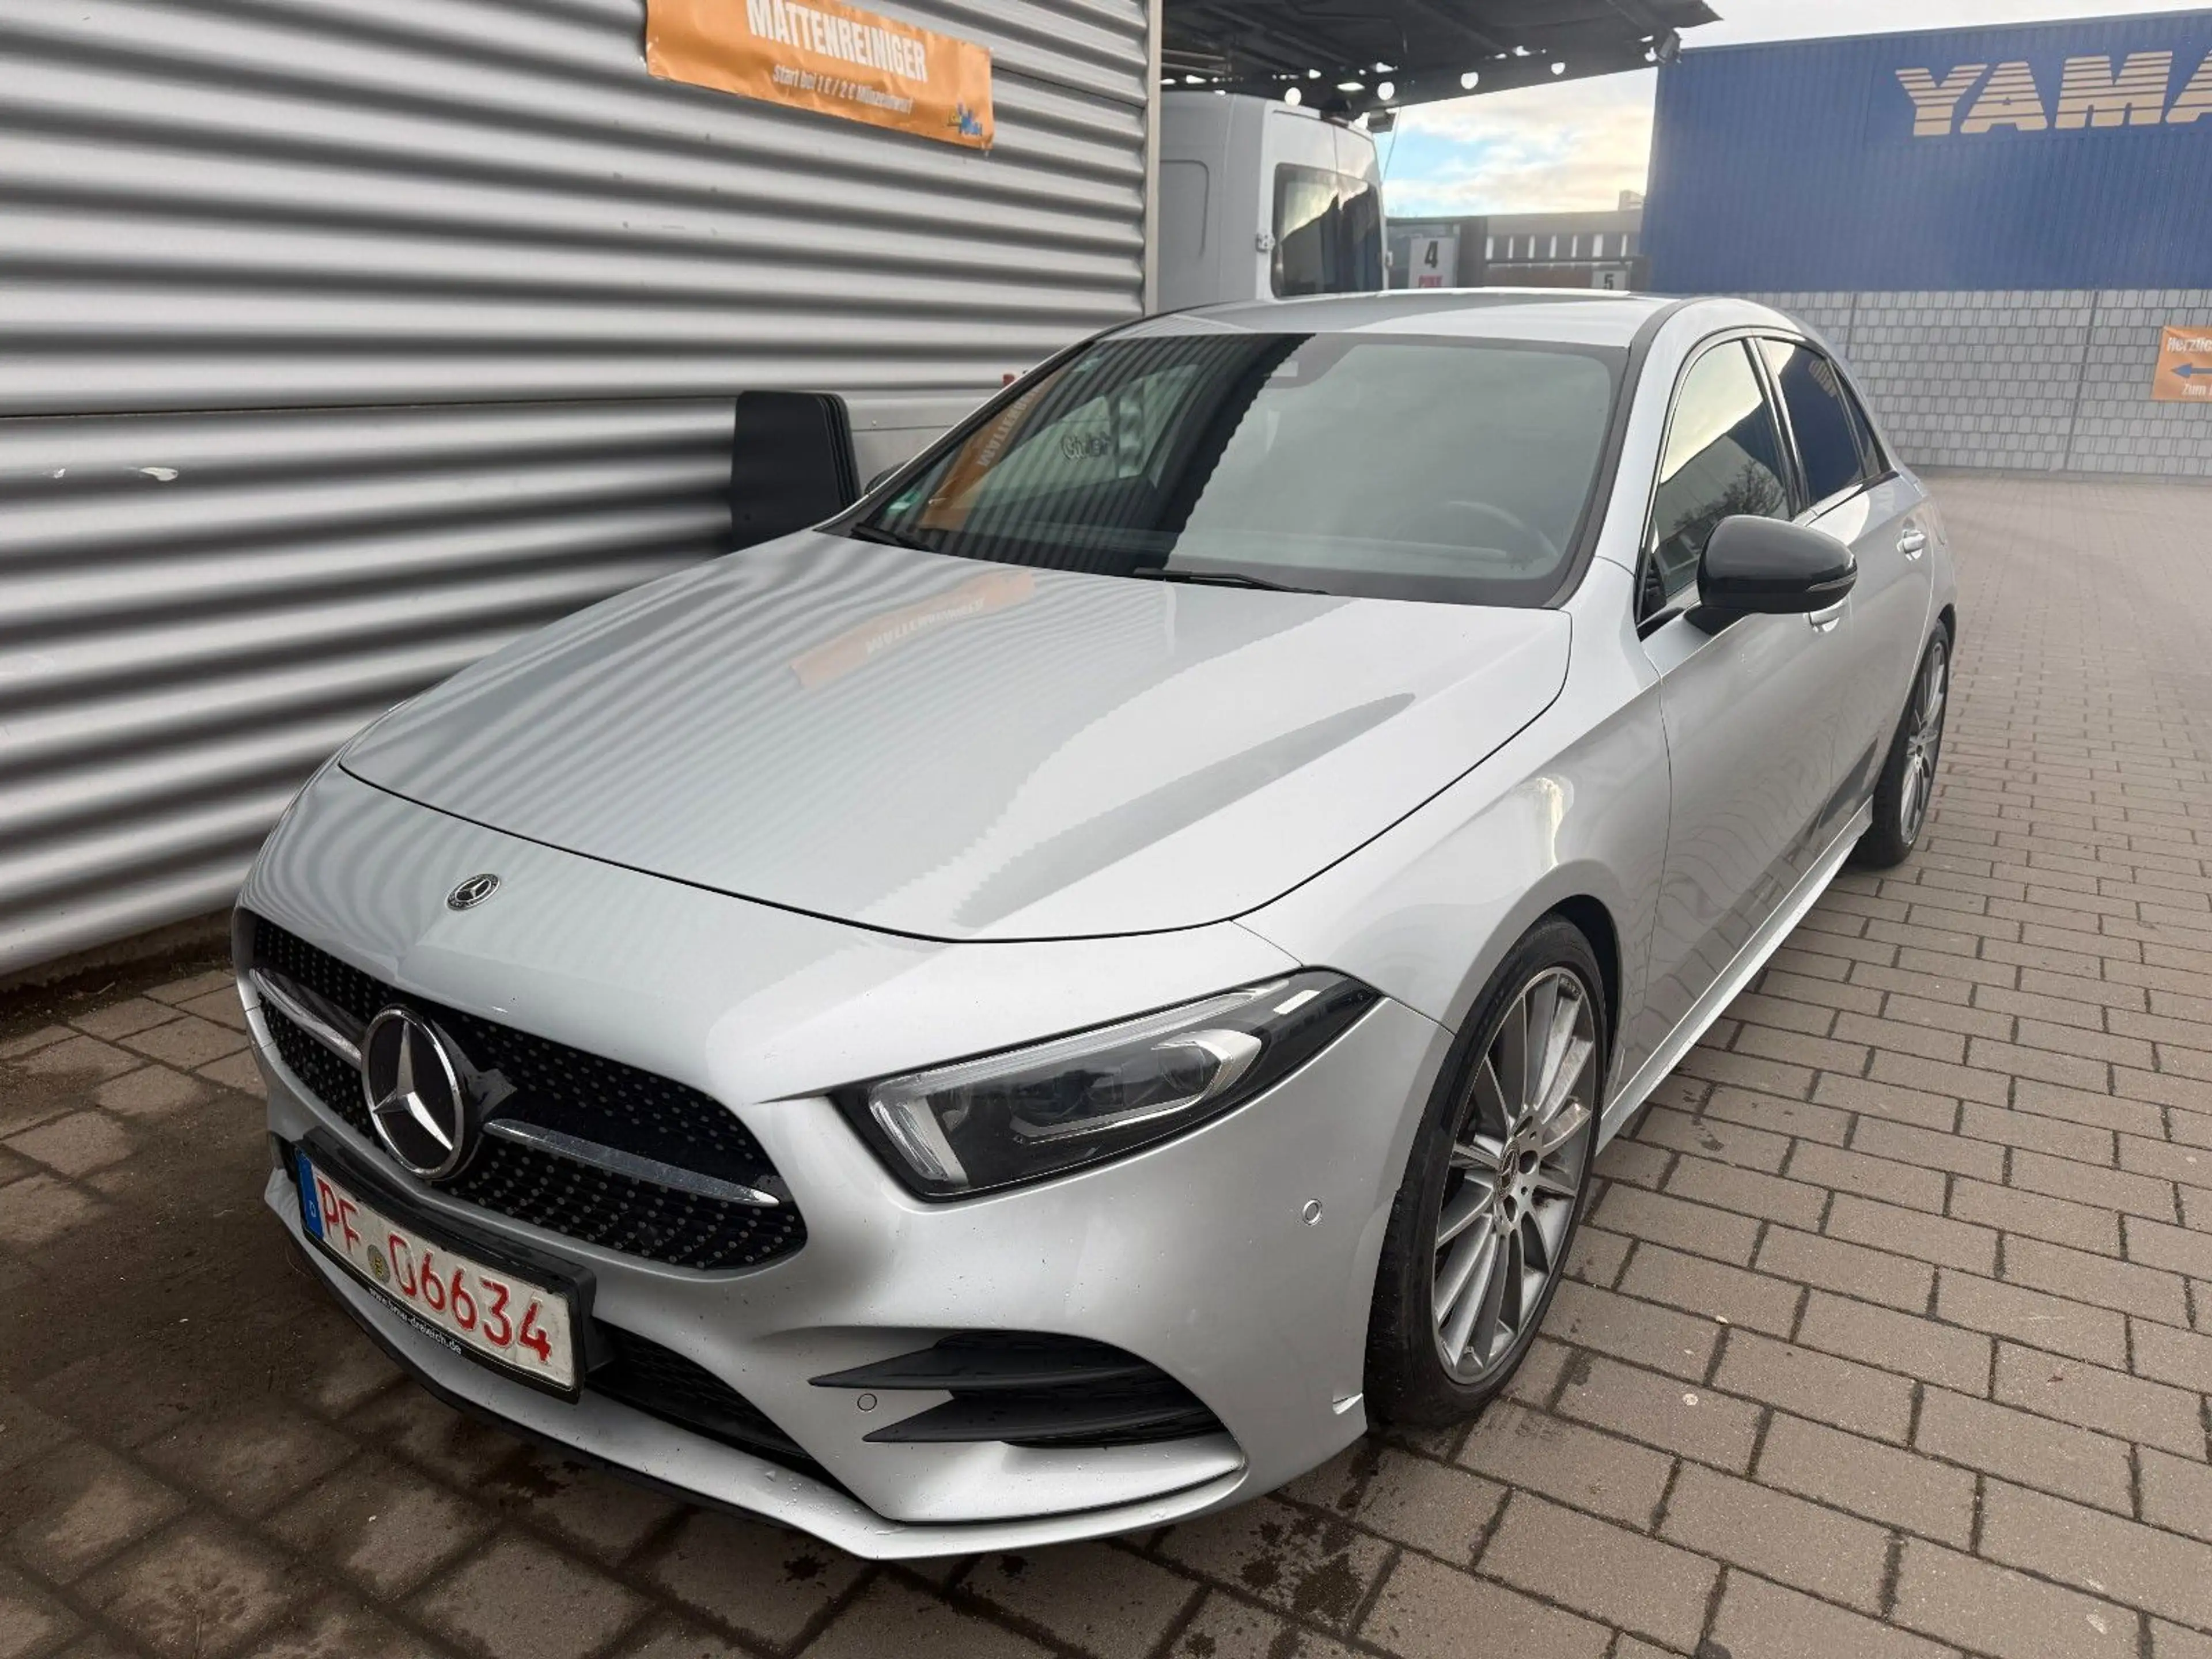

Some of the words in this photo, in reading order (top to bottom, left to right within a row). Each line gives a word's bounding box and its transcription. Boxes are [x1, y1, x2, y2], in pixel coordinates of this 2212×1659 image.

[747, 0, 927, 82] MATTENREINIGER
[773, 64, 799, 88] start
[1425, 241, 1438, 268] 4
[1603, 274, 1614, 290] 5
[317, 1176, 362, 1256] PF
[388, 1231, 553, 1364] 06634
